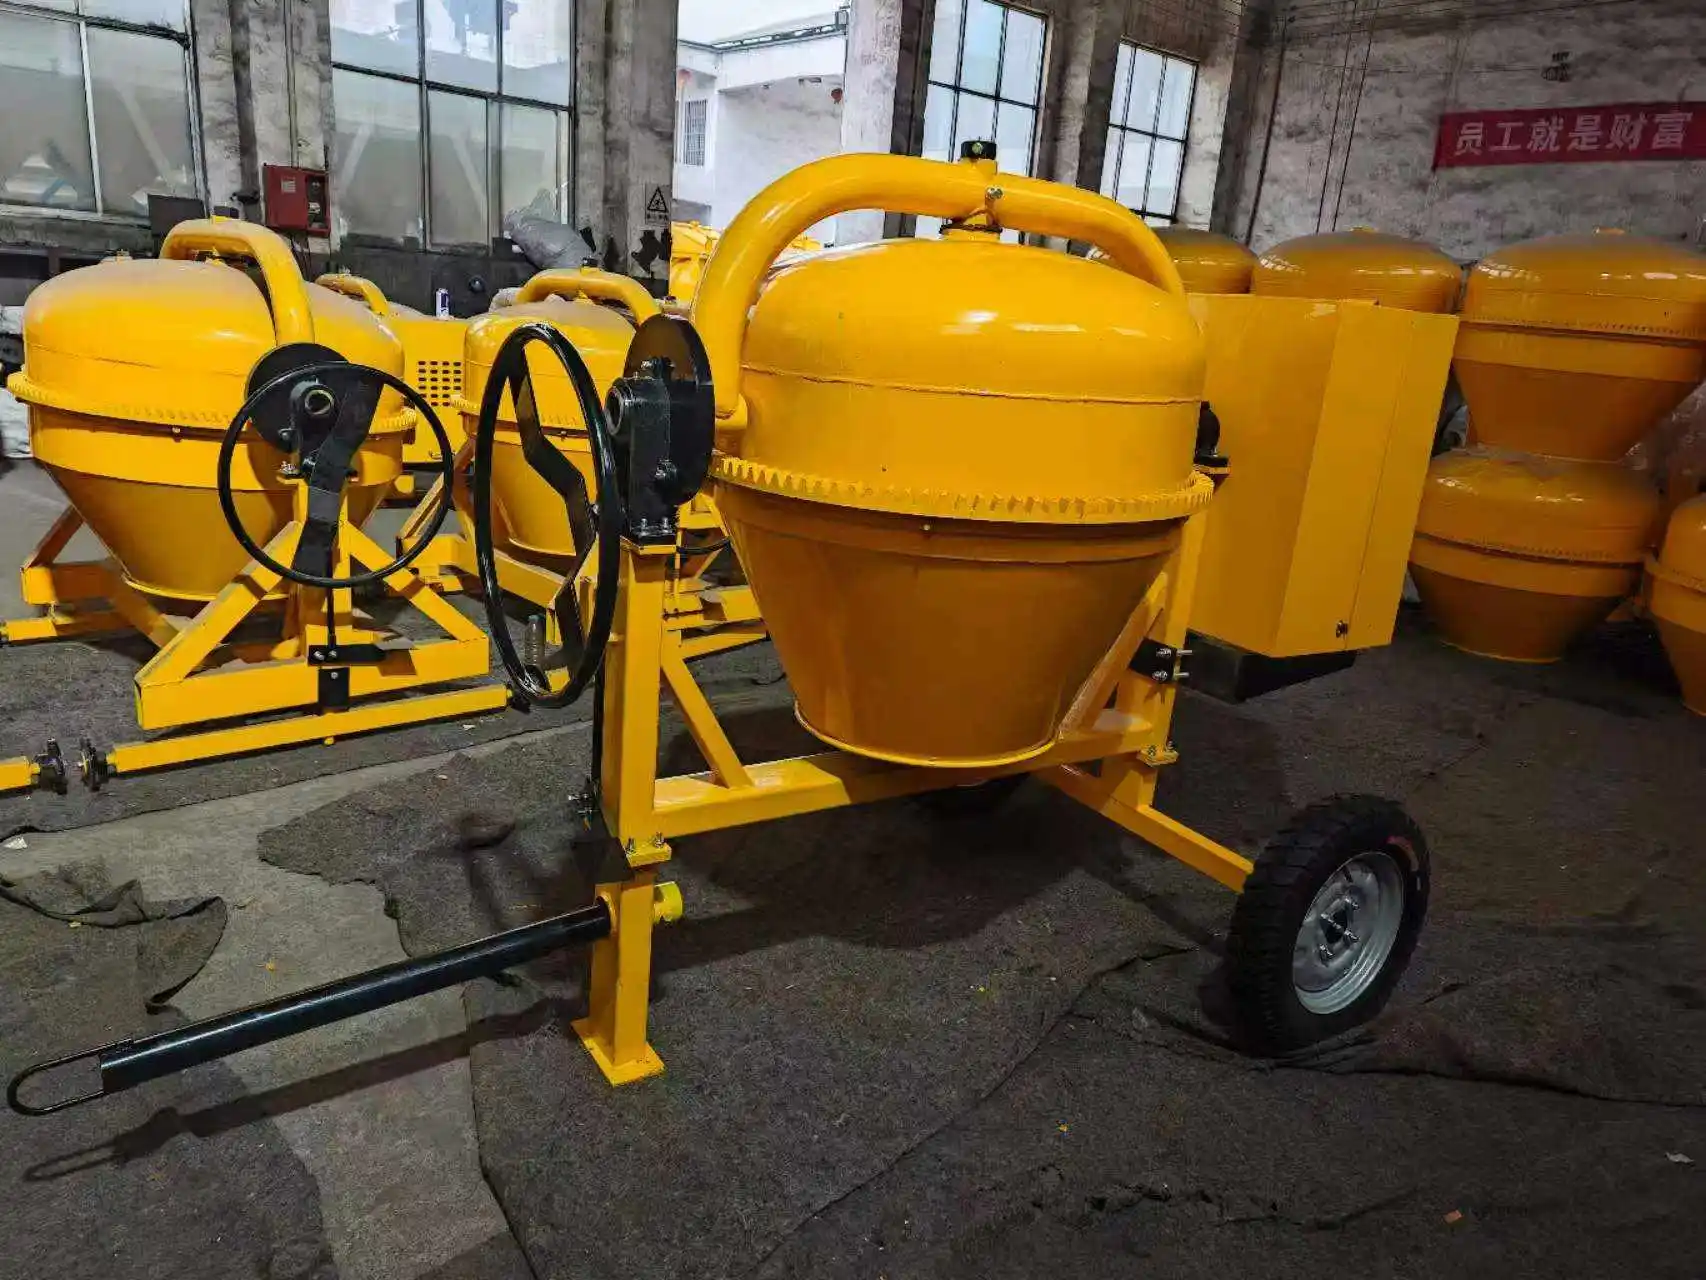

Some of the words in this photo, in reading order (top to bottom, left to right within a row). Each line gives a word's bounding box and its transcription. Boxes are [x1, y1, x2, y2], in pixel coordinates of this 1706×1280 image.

[1454, 112, 1692, 156] 员工就是财富
